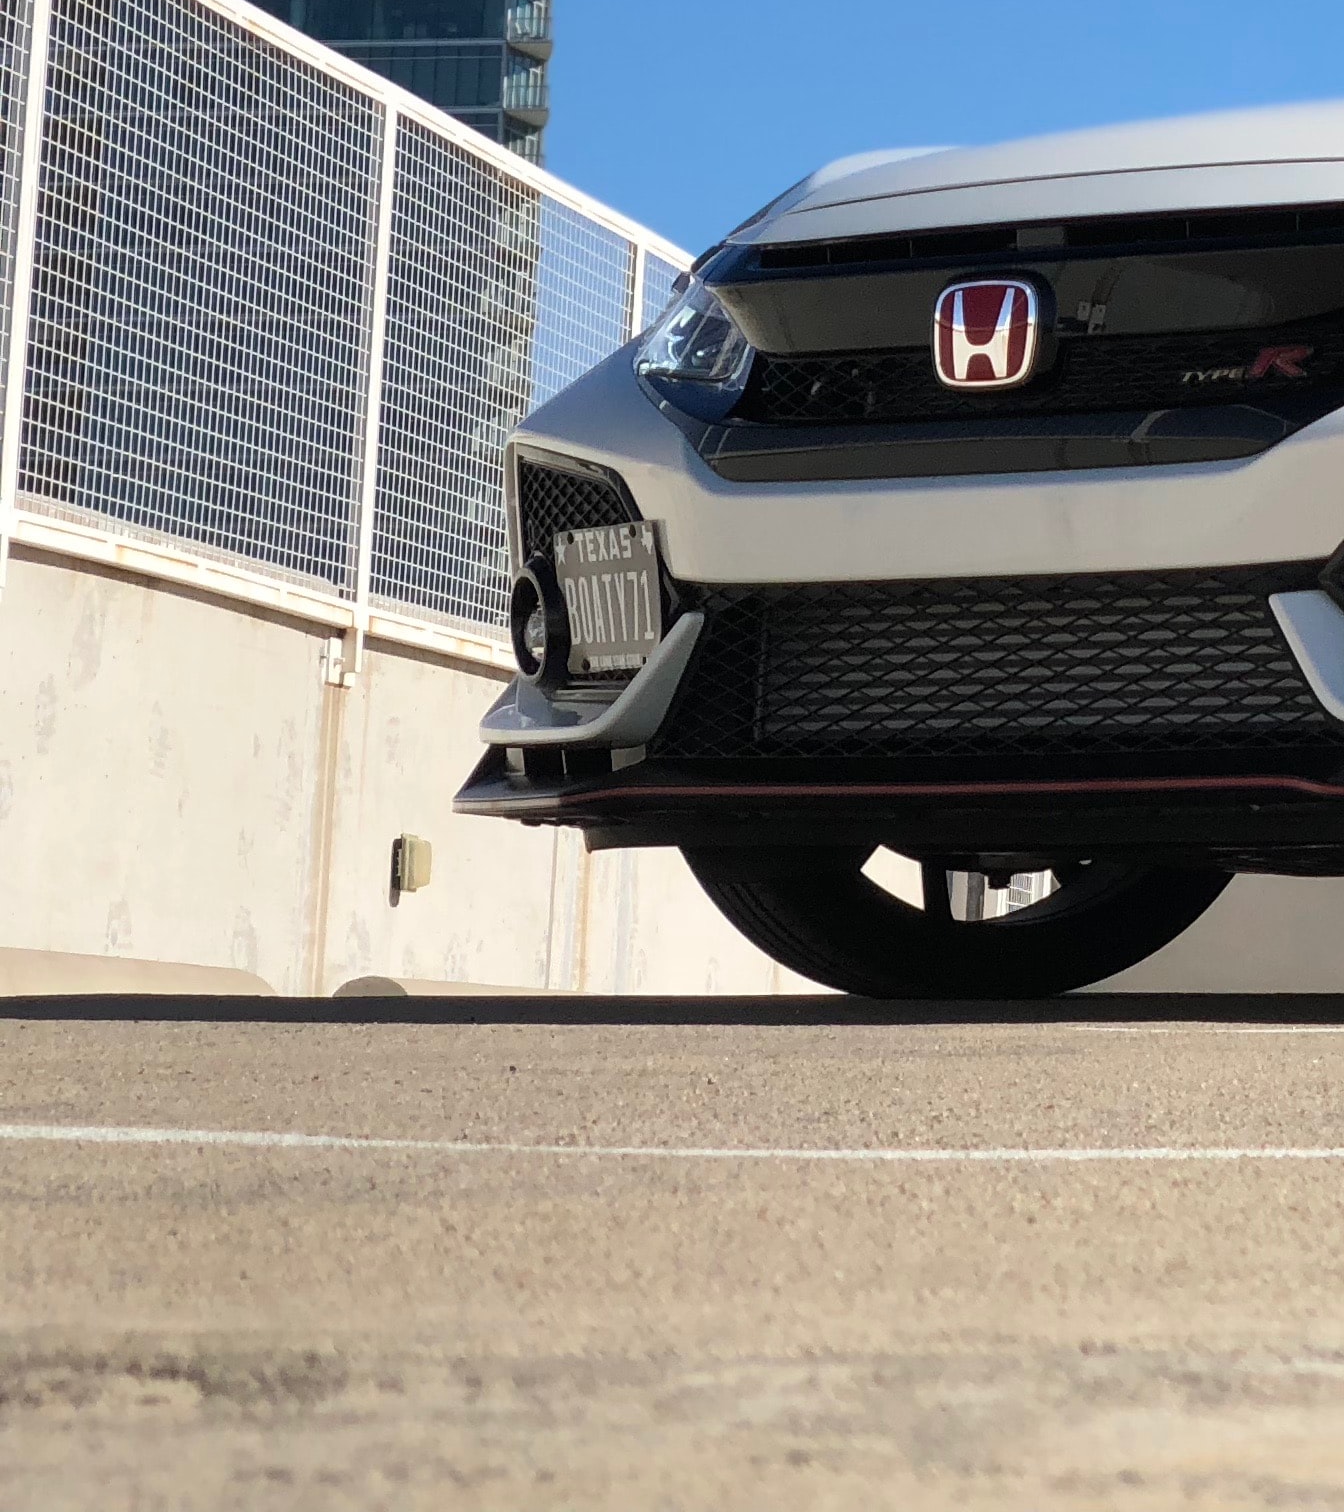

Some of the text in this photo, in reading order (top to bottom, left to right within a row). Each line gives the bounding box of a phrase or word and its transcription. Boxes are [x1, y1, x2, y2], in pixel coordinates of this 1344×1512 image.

[1182, 344, 1314, 383] TYPE R
[574, 527, 632, 564] TEXAS
[564, 569, 655, 646] BOATY71
